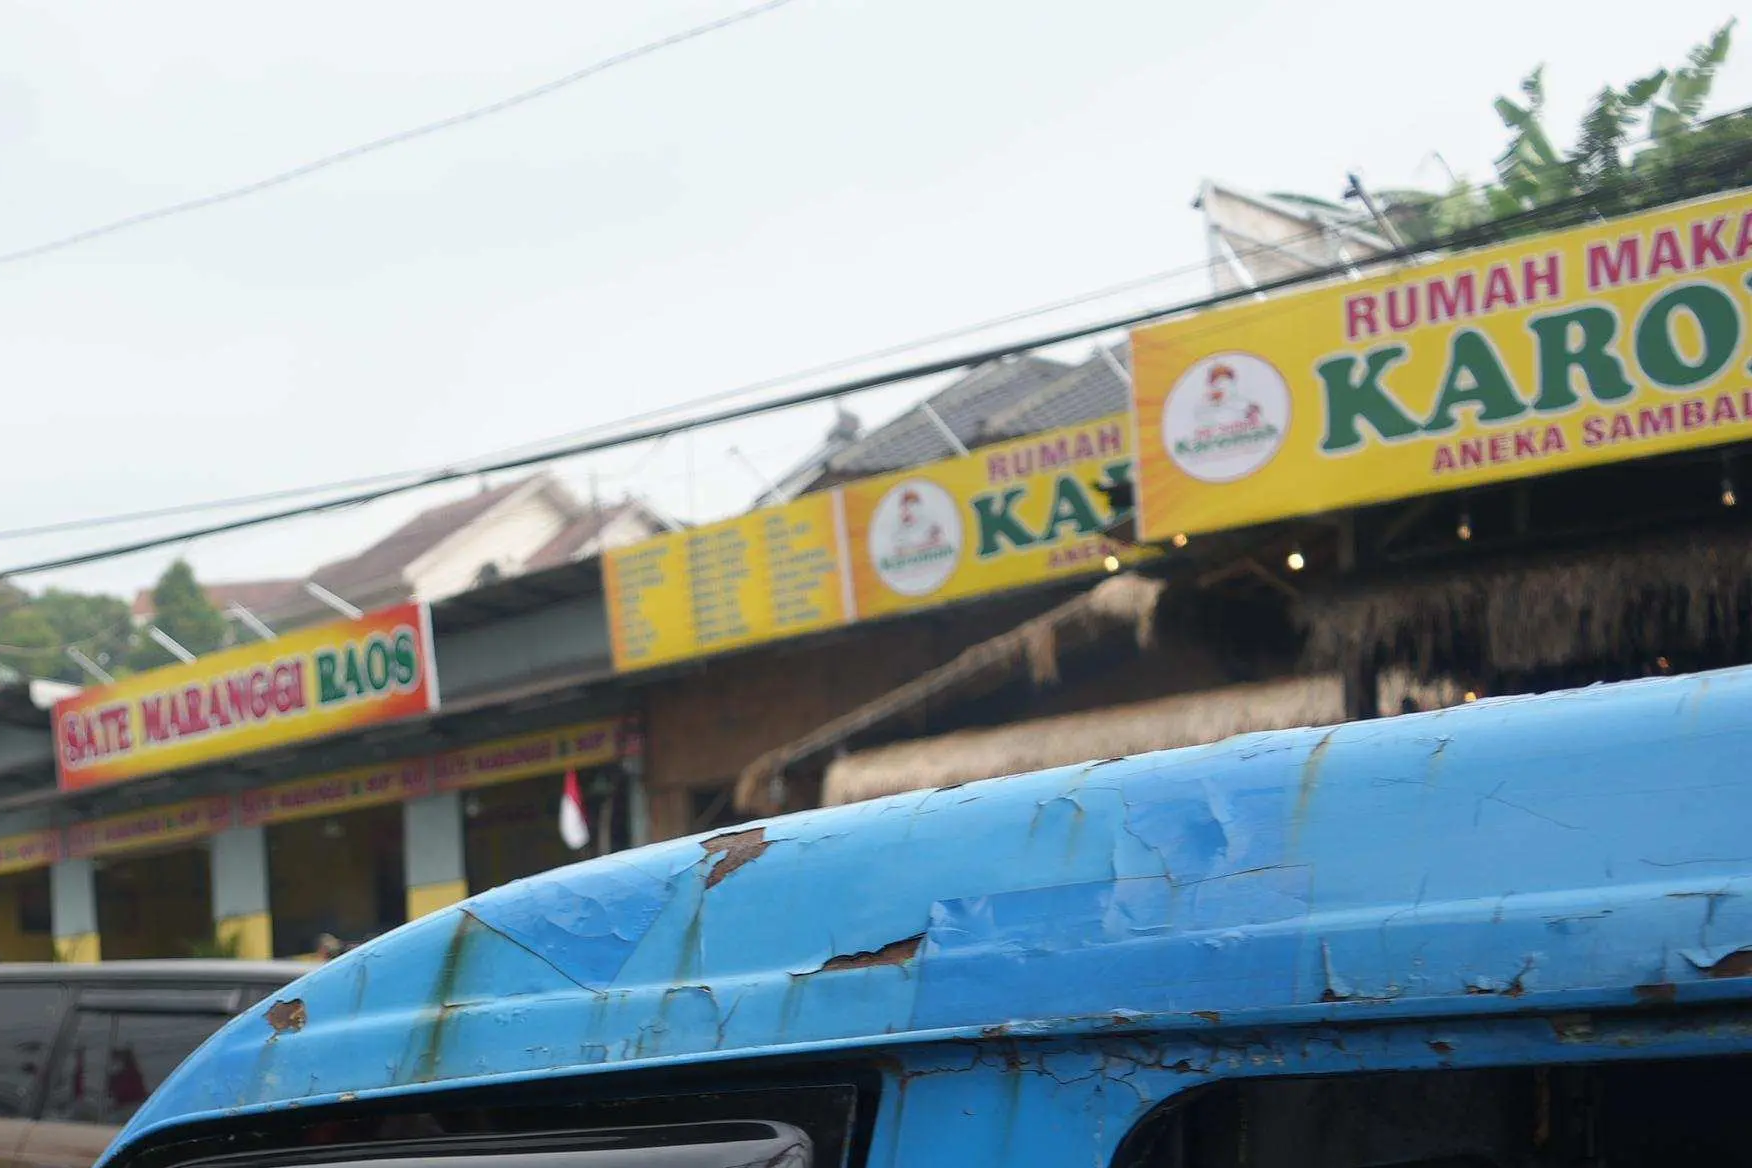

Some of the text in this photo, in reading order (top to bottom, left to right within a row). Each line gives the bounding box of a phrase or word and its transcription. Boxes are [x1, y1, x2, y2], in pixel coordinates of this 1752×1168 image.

[1346, 254, 1560, 341] RUMAH
[1316, 270, 1752, 451] KARO
[987, 425, 1122, 481] RUMAH
[1432, 423, 1567, 472] ANEKA
[64, 631, 417, 762] SATE MARANGGI RAOS
